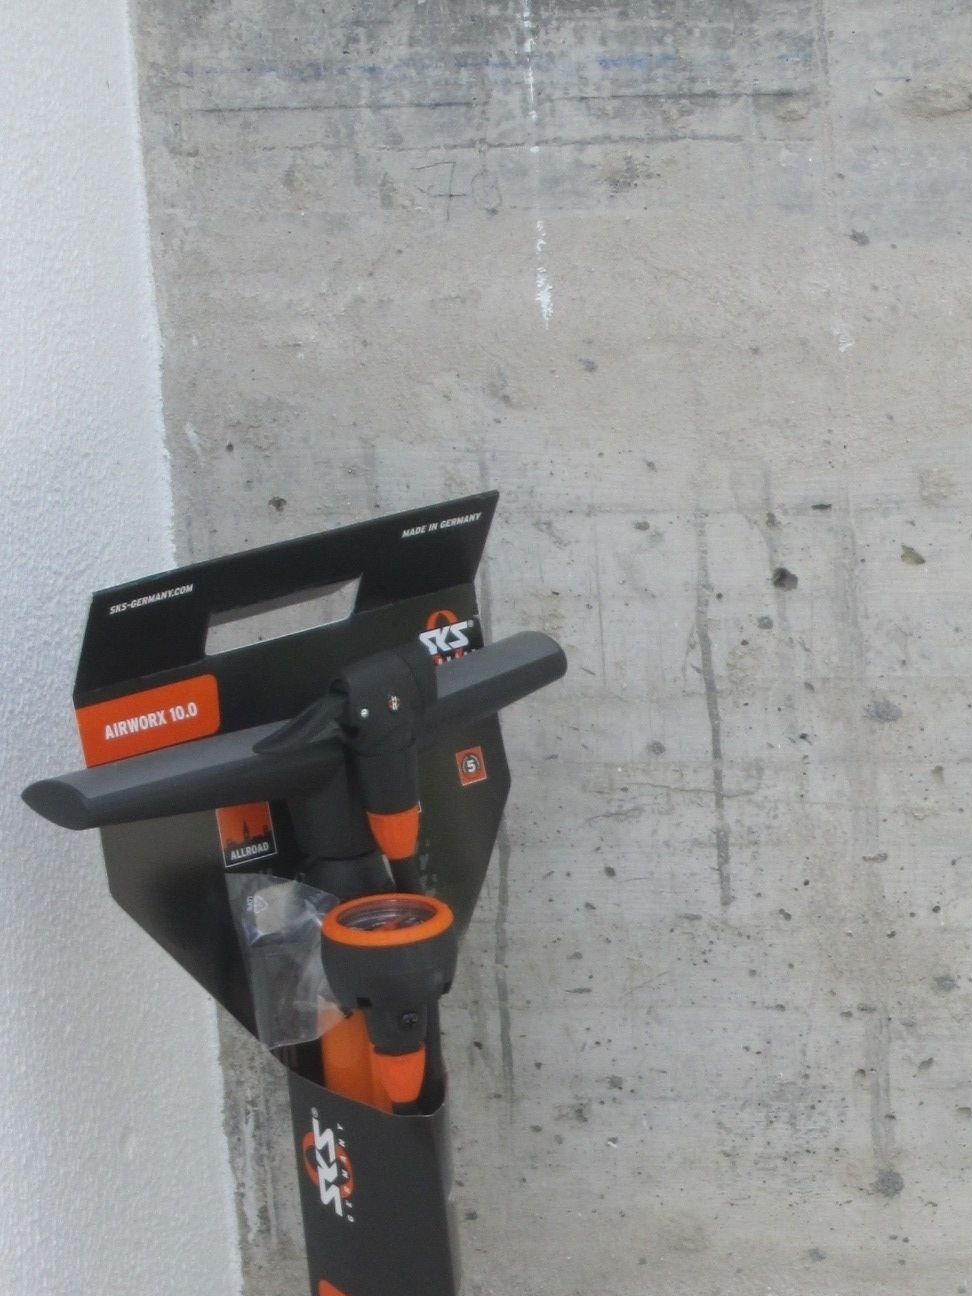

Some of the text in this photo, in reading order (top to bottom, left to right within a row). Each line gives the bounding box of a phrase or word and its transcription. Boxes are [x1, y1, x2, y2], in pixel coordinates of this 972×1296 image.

[402, 512, 482, 538] MADE IN GERMANY
[109, 584, 194, 615] SKS-GERMANY.COM
[105, 702, 198, 740] AIRWORX 10.0
[230, 841, 270, 861] ALLROAD
